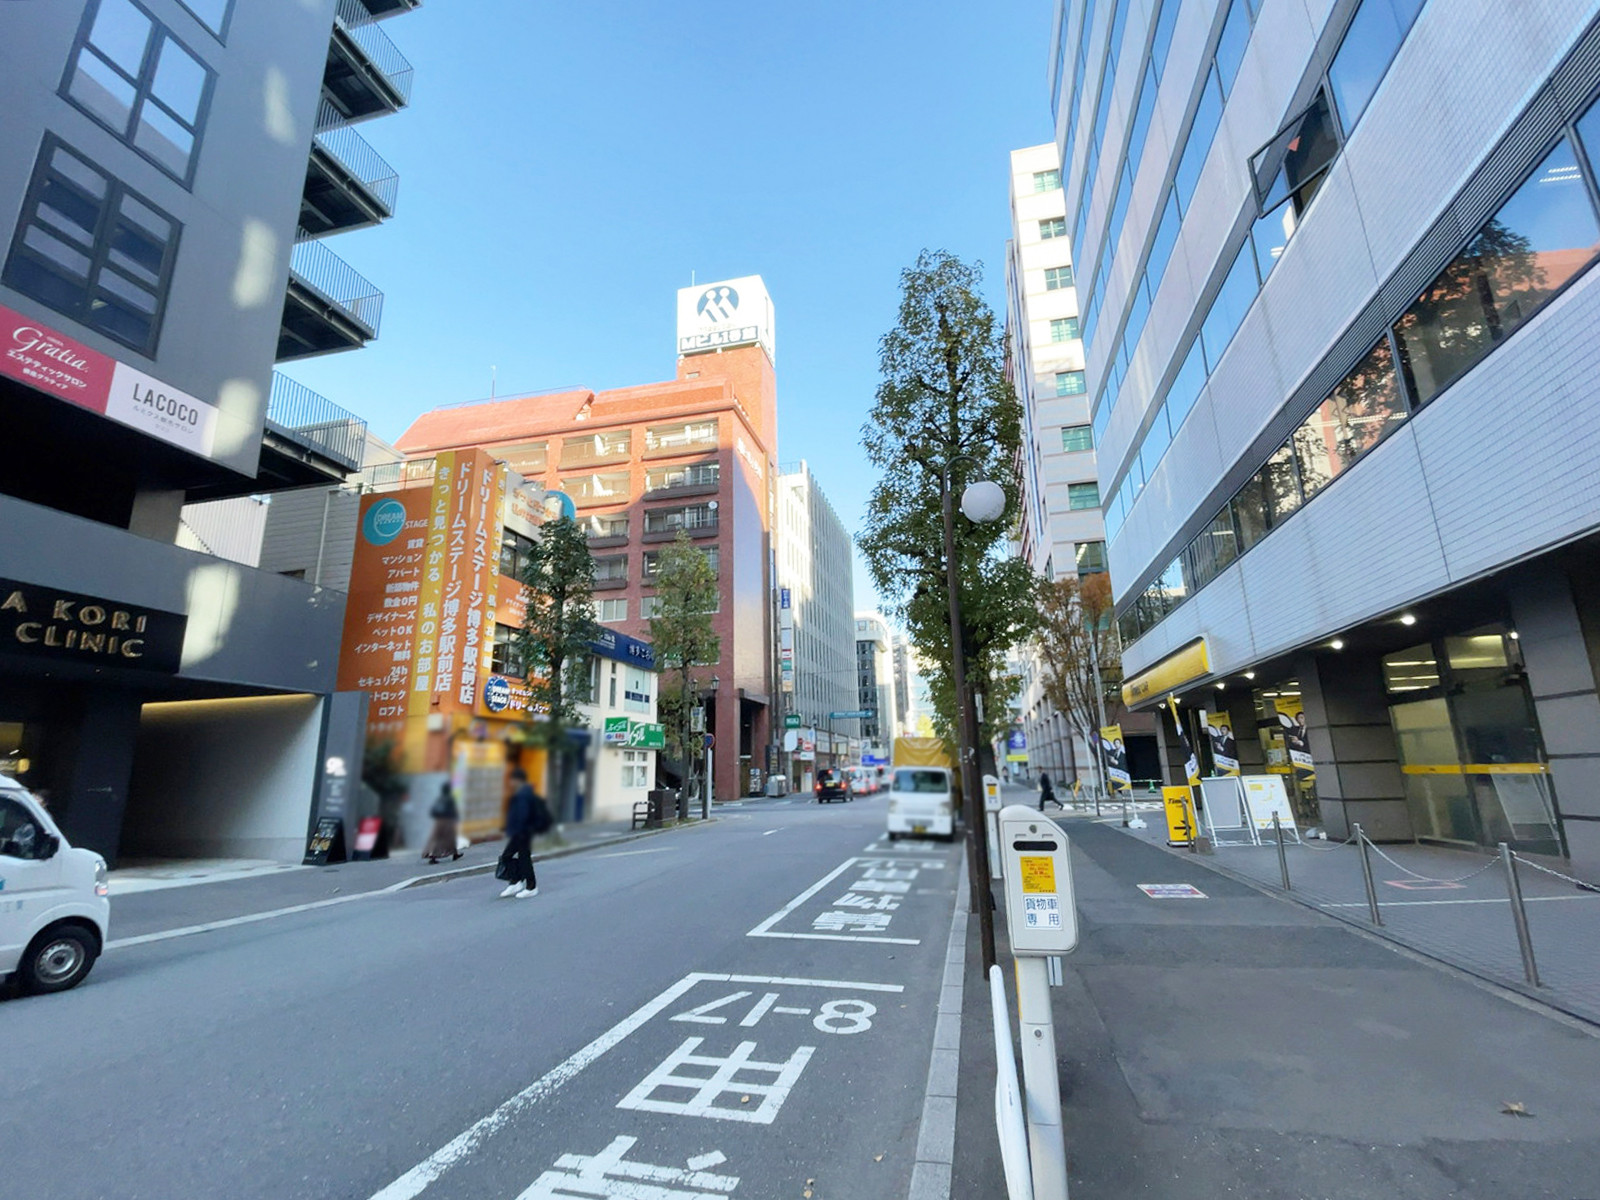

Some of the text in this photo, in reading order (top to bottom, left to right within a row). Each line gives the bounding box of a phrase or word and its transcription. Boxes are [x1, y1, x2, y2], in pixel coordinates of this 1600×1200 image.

[133, 383, 198, 426] LACOCO
[405, 519, 428, 529] STAGE
[382, 553, 422, 565] マンション
[387, 567, 420, 579] アパート
[414, 466, 450, 690] きっと見つかる、私のお部屋
[432, 462, 473, 691] ドリームステージ博多駅前店
[459, 469, 493, 705] ドリームステージ博多駅前店
[53, 599, 147, 633] KORI
[367, 609, 417, 624] デザイナーズ
[16, 622, 145, 658] CLINIC
[354, 639, 411, 654] インターネット
[358, 675, 407, 687] セキュリティ
[369, 689, 406, 702] トロック
[378, 705, 405, 716] ロフト
[1168, 797, 1189, 805] Tims
[1026, 898, 1058, 911] 貨物車
[668, 991, 877, 1034] 8-17
